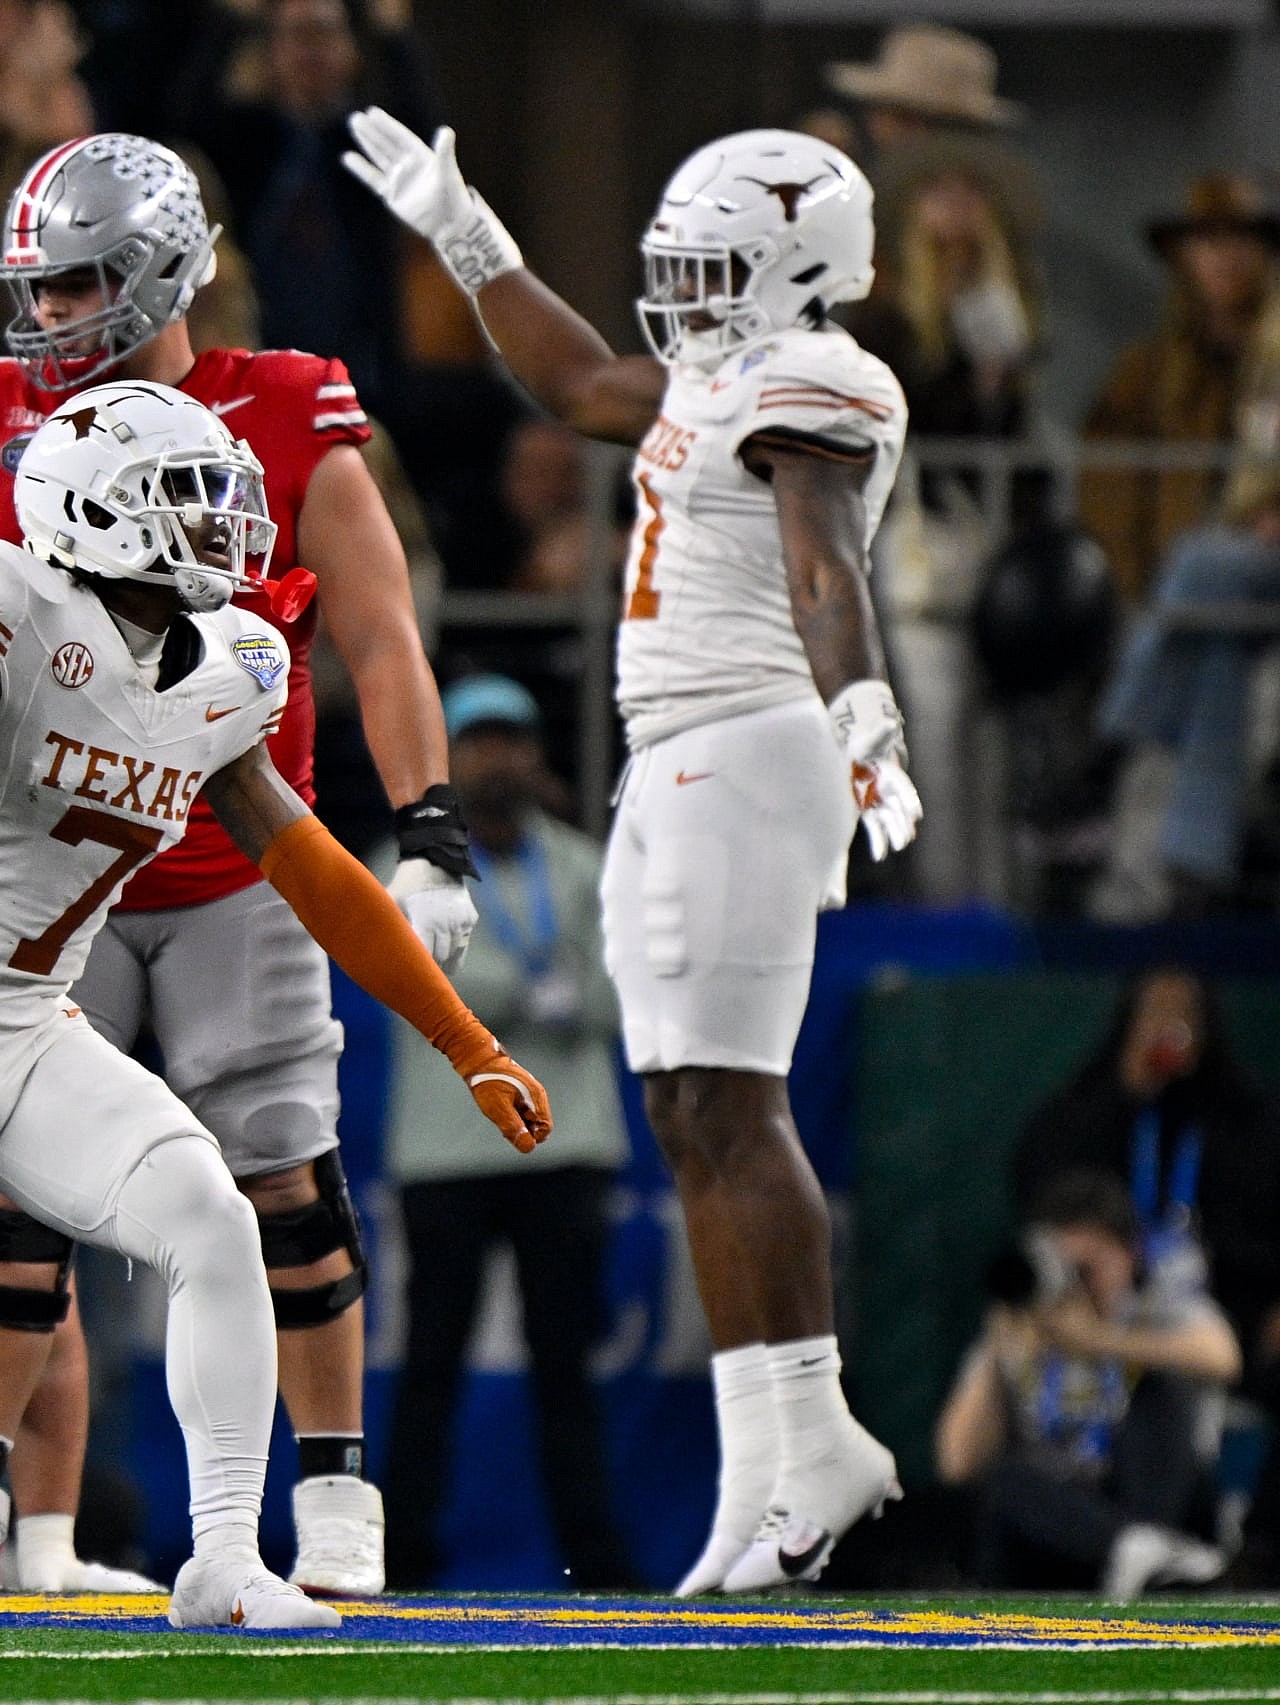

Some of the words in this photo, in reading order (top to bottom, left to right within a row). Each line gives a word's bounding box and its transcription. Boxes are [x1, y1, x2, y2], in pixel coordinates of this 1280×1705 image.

[52, 642, 94, 688] SEC
[41, 730, 204, 822] TEXAS
[8, 805, 166, 976] 7
